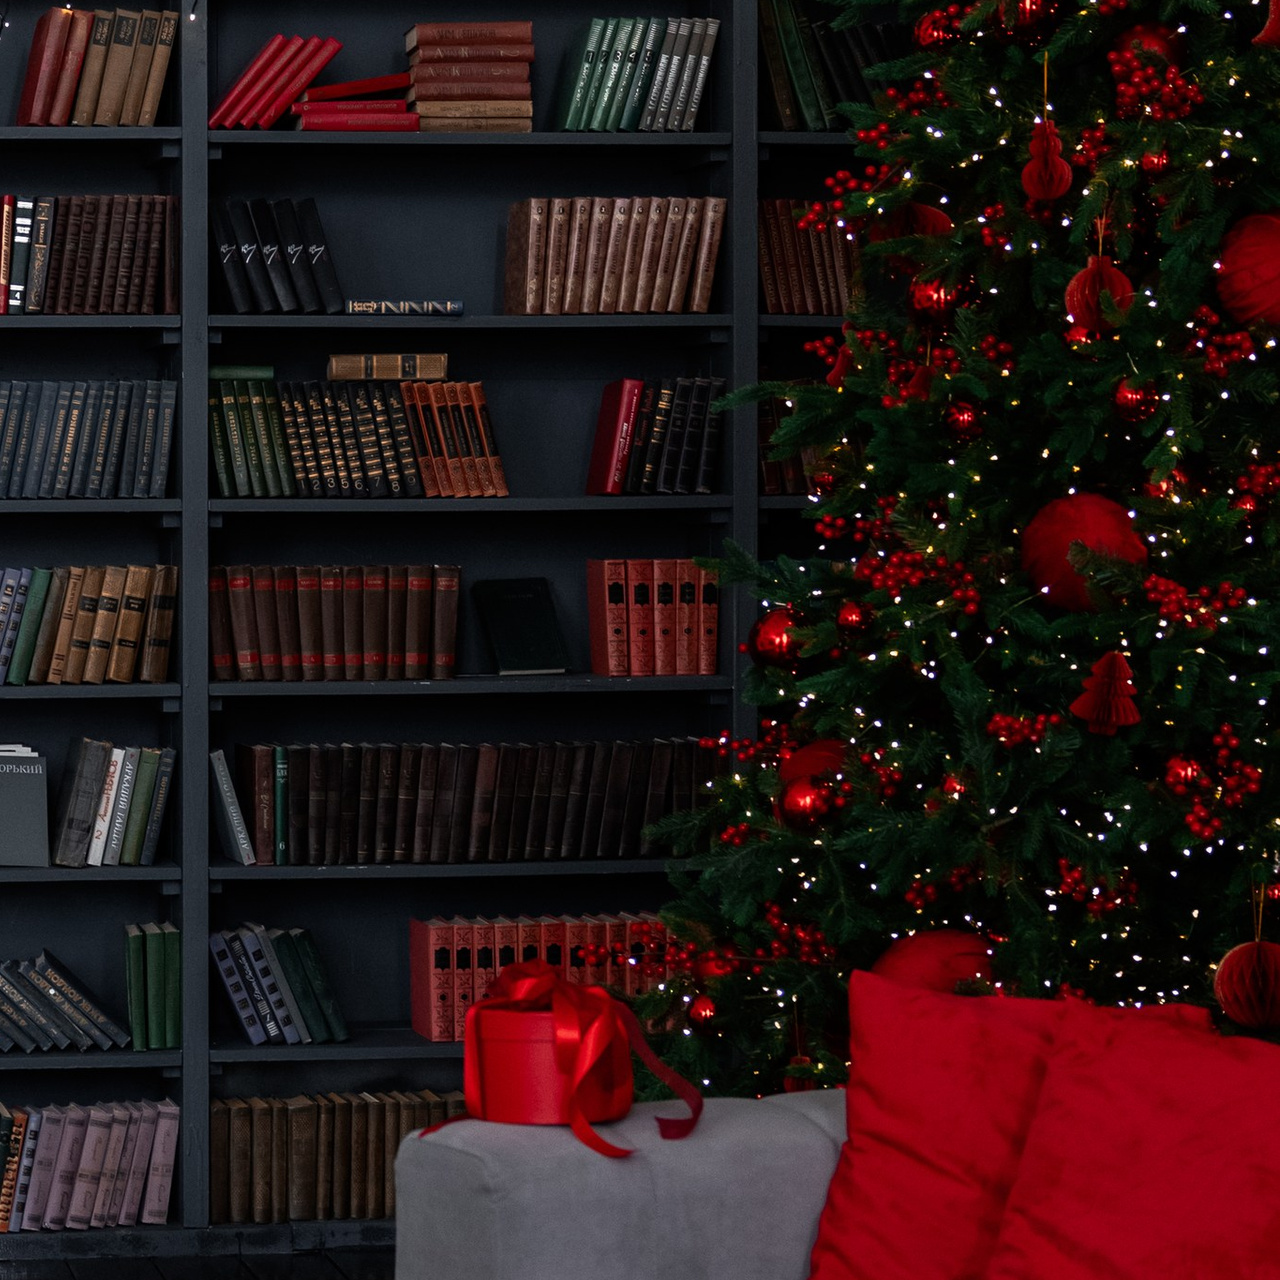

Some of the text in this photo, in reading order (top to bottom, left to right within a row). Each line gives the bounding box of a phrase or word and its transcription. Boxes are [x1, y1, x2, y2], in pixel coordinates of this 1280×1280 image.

[311, 478, 321, 491] 2
[326, 476, 336, 488] 3
[391, 480, 401, 492] 8
[118, 761, 135, 810] АРКАДИЙ
